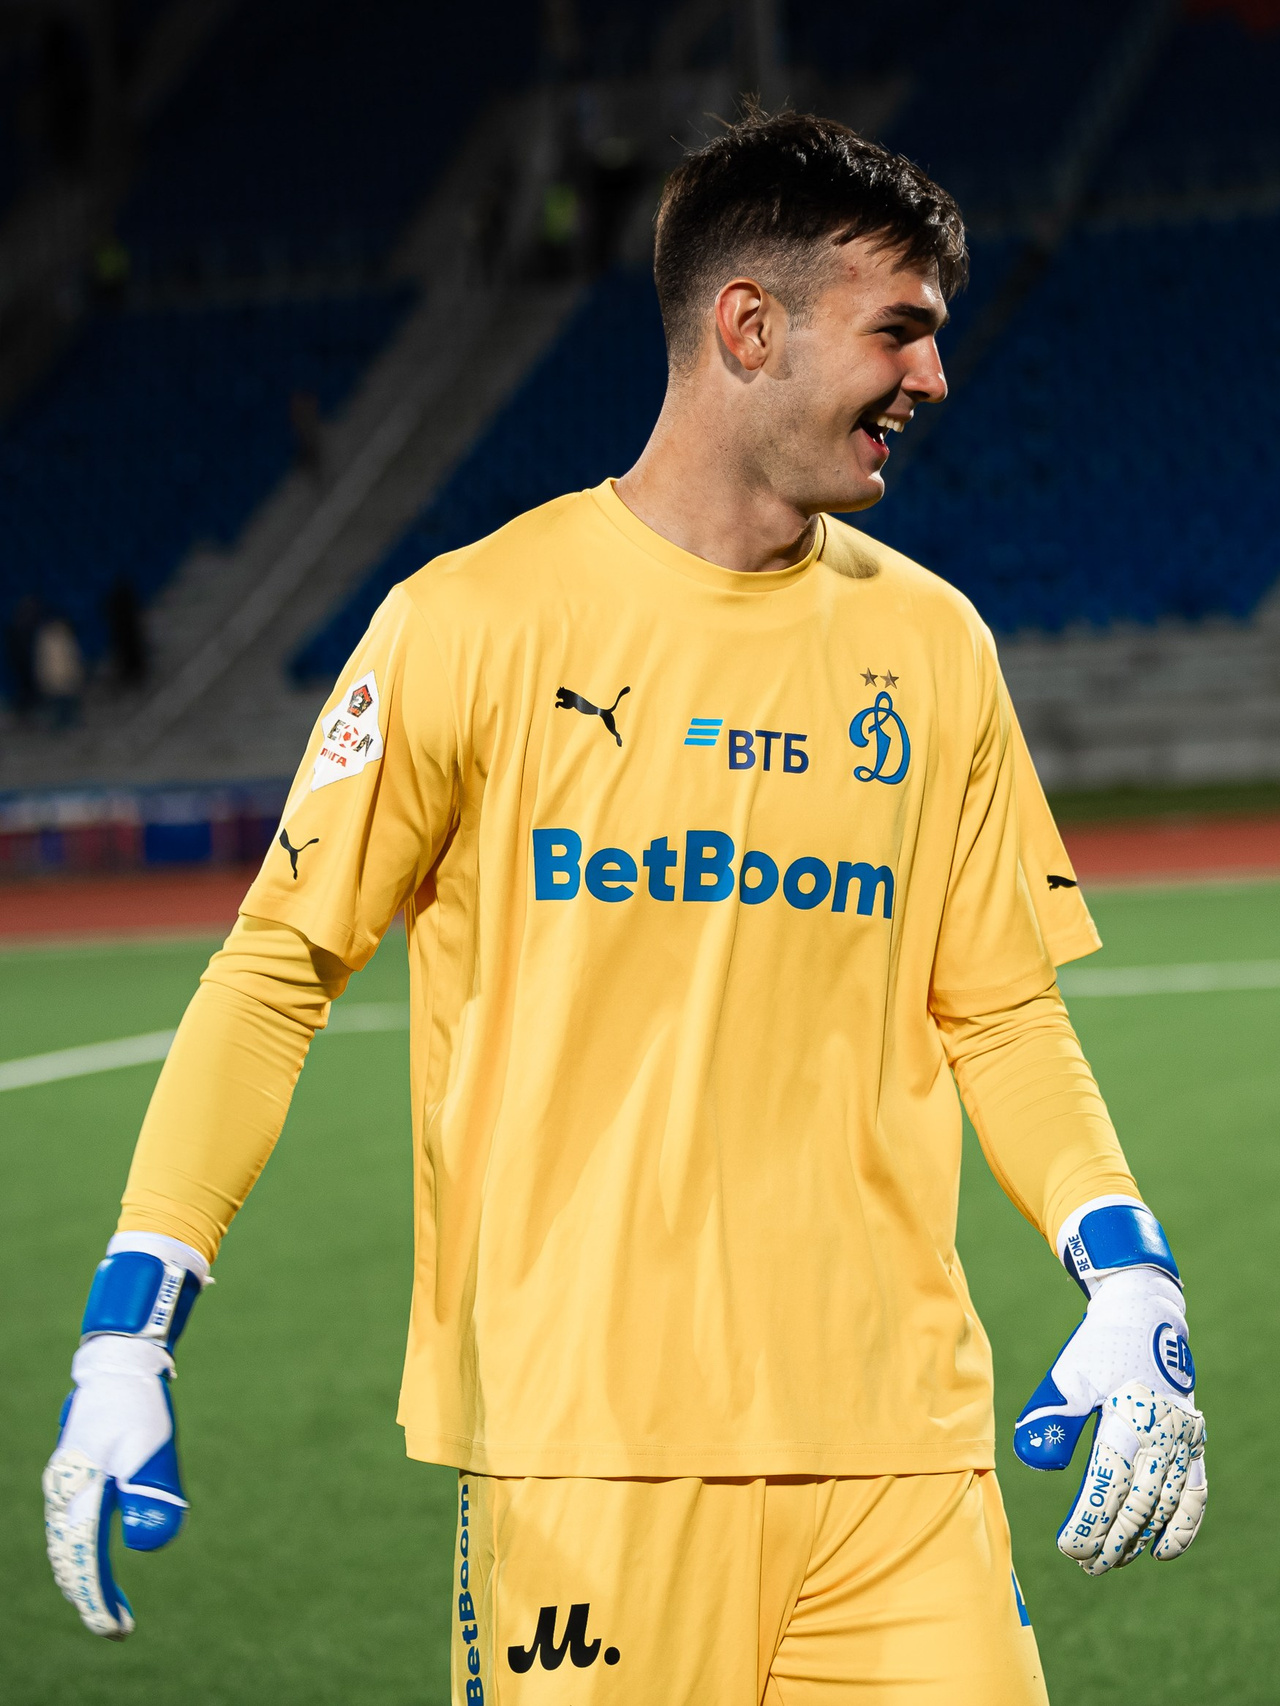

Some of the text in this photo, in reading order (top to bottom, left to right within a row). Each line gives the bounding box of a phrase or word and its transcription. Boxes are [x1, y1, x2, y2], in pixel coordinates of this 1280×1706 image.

[728, 729, 810, 774] ВТБ
[532, 828, 894, 919] BetBoom
[1067, 1234, 1091, 1272] BE ONE
[1075, 1466, 1114, 1537] BE ONE
[458, 1483, 484, 1706] BetBoom
